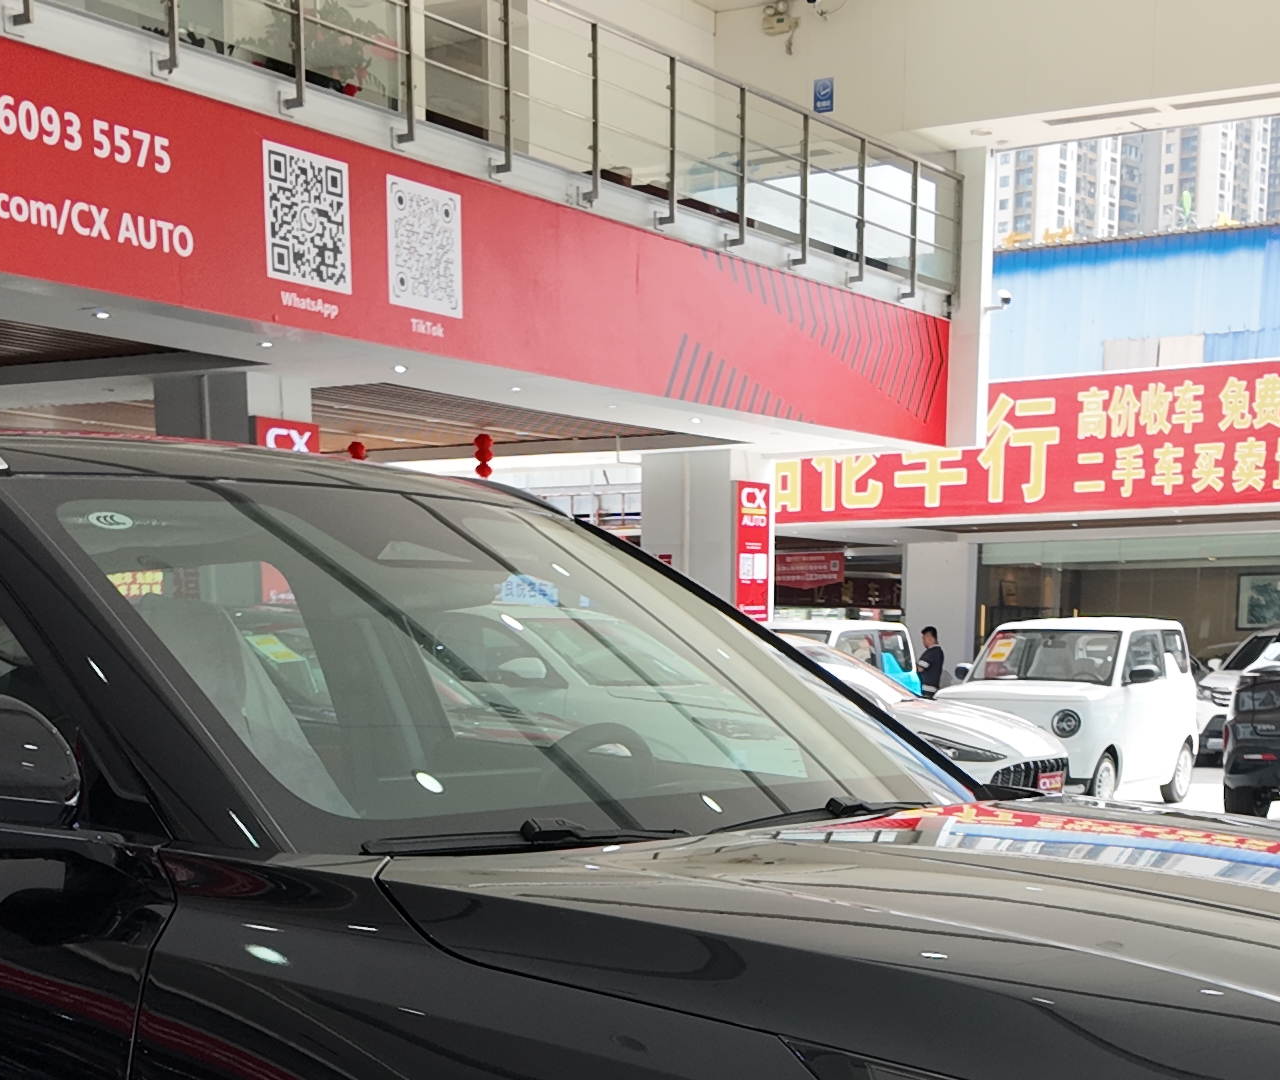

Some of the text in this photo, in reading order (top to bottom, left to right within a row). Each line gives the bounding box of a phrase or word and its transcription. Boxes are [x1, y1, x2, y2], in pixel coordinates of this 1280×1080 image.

[92, 118, 172, 174] 5575
[117, 212, 195, 258] AUTO
[280, 290, 340, 320] WhatsApp
[409, 317, 445, 338] TikTok
[1076, 380, 1206, 440] 高价收车
[265, 427, 312, 453] CX
[741, 487, 768, 509] CX
[741, 515, 768, 527] AUTO
